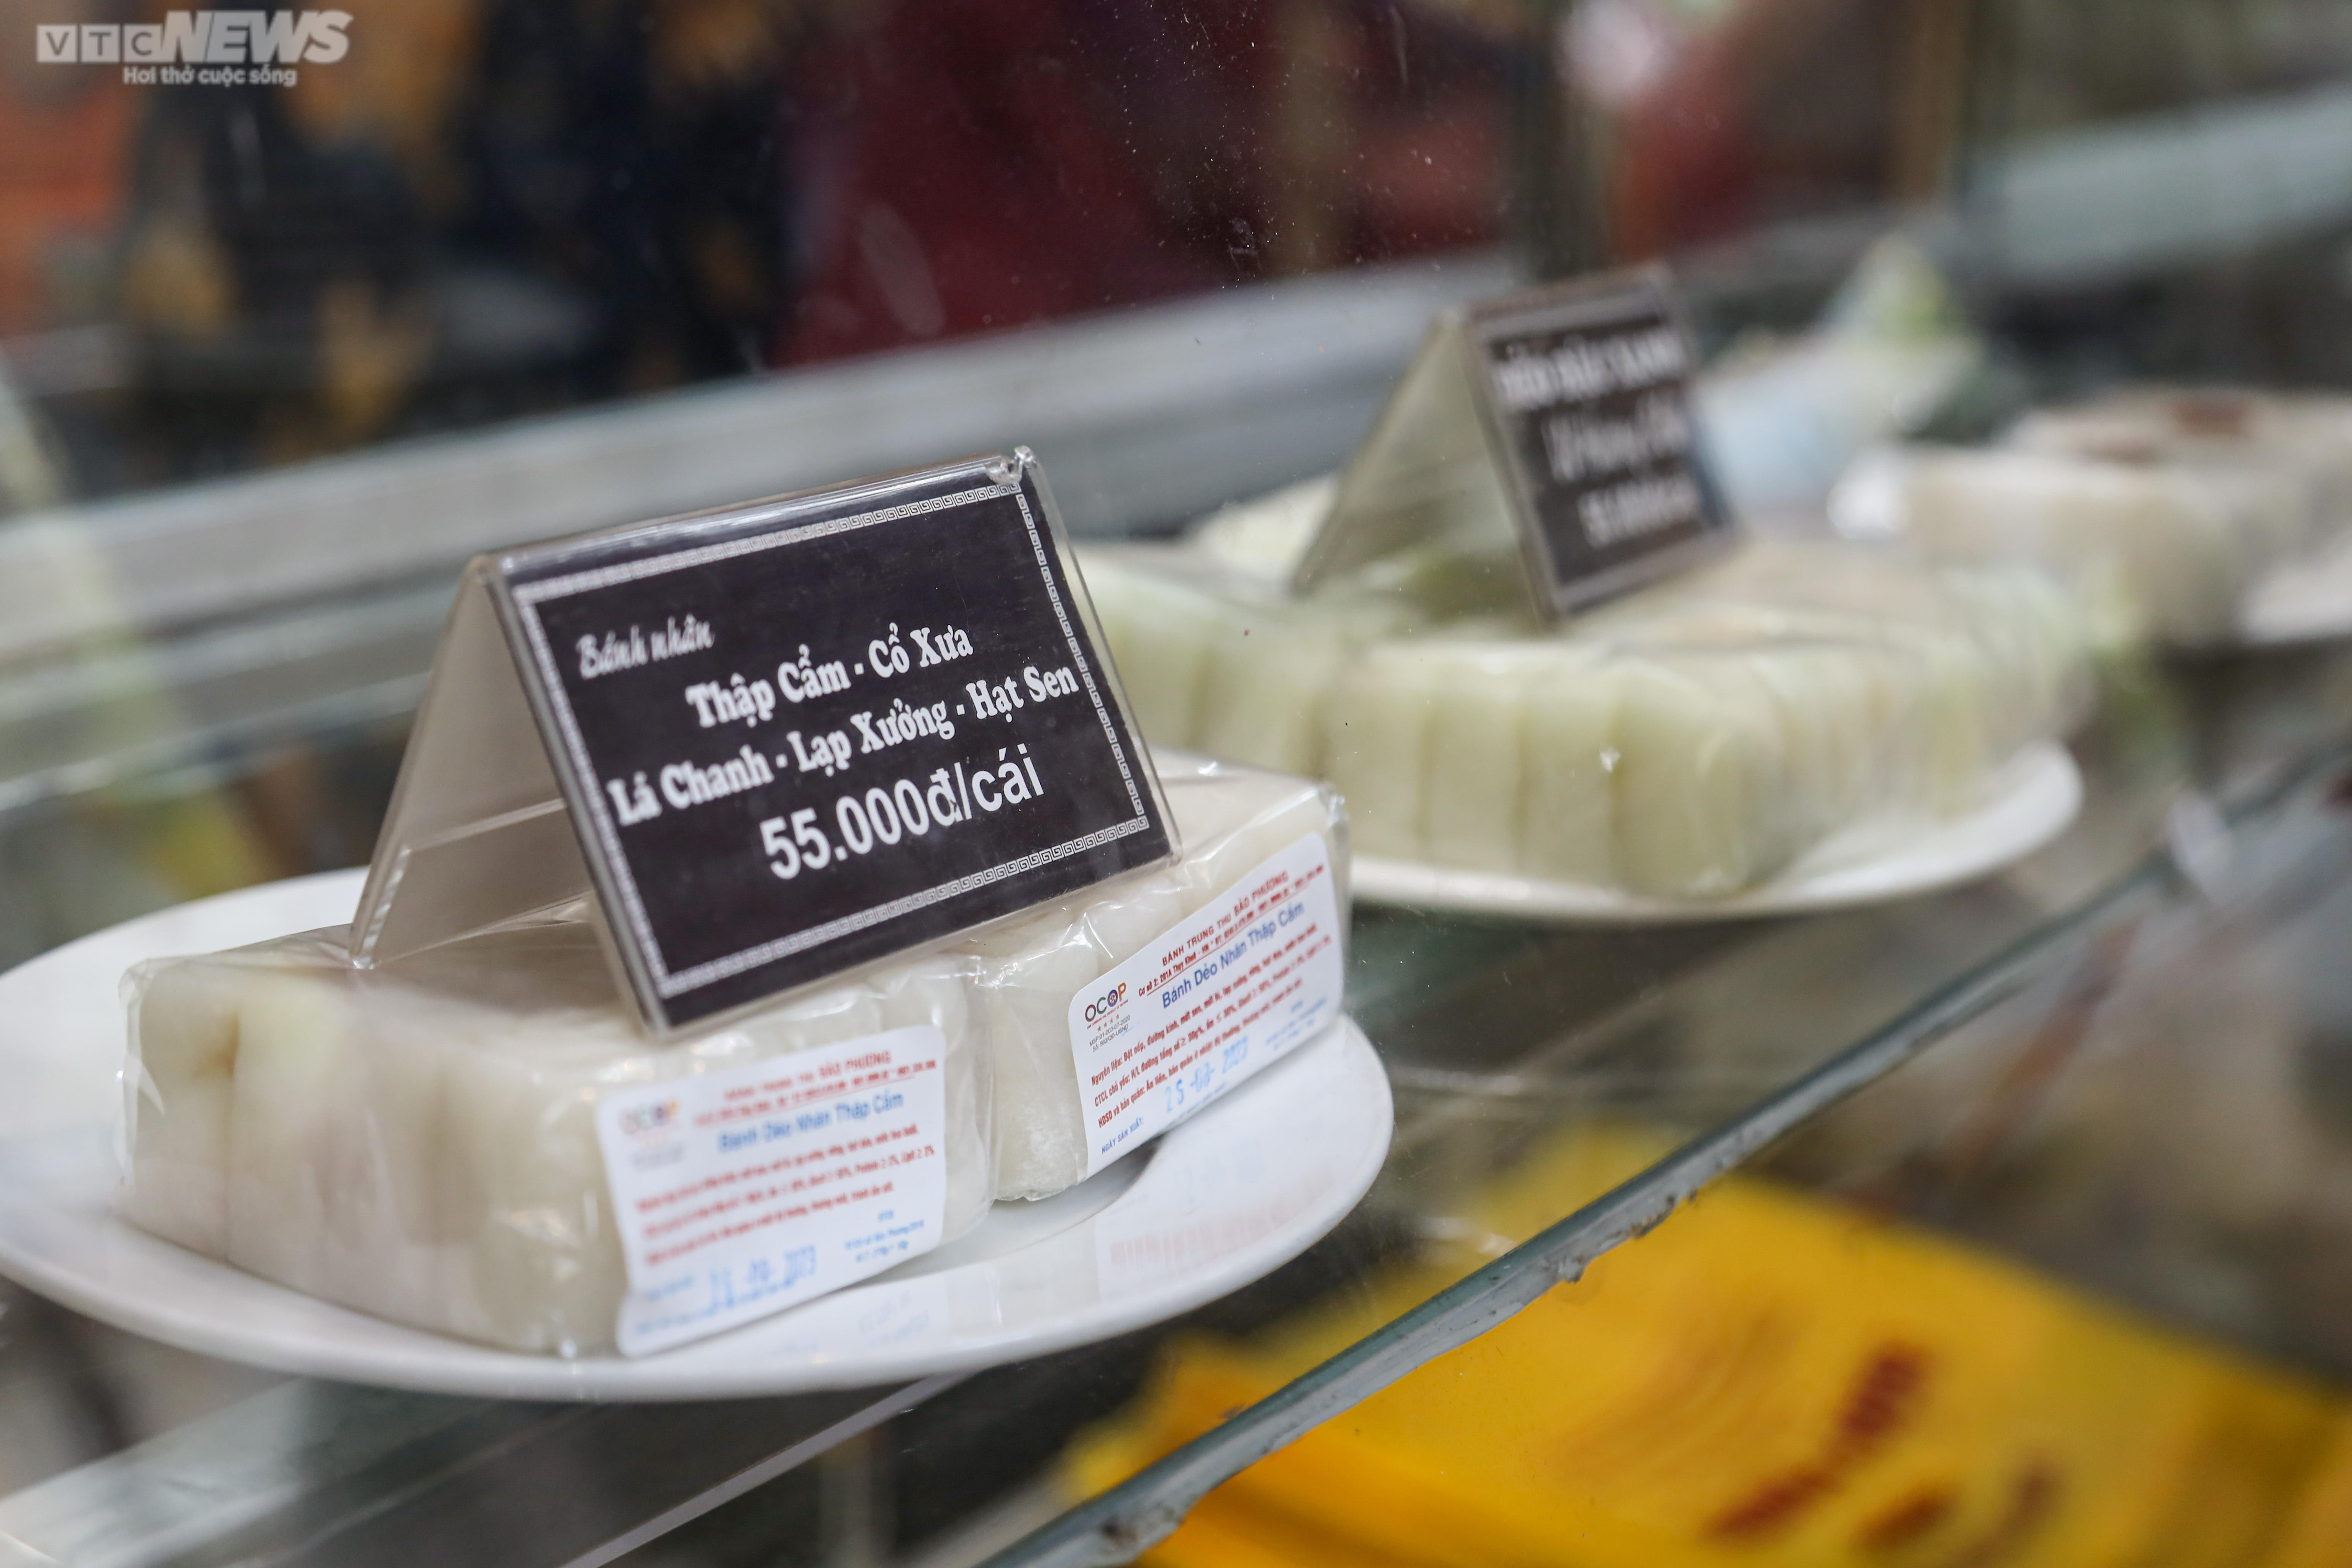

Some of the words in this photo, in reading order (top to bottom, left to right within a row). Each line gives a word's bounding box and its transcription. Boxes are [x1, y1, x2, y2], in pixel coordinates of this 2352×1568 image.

[578, 629, 648, 680] Bánh
[651, 614, 715, 664] nhân
[686, 675, 776, 730] Thập
[778, 644, 852, 704] Cẩm
[868, 622, 910, 679] Cổ
[910, 625, 974, 668] Xưa
[608, 769, 662, 828] Lá
[663, 746, 774, 811] Chanh
[787, 730, 852, 778] Lạp
[851, 699, 955, 755] Xưởng
[967, 678, 1025, 724] Hạt
[1023, 664, 1079, 703] Sen
[760, 743, 1045, 881] 55.000đ/cái
[1162, 945, 1184, 967] BÁNH
[1187, 925, 1214, 949] TRUNG
[1217, 913, 1231, 929] THU
[1162, 979, 1191, 1008] Bánh
[1194, 963, 1217, 986] Dẻo
[1220, 941, 1247, 970] Nhân
[1085, 982, 1127, 1022] OCOP
[1091, 1067, 1110, 1087] Nguyên
[1111, 1059, 1123, 1071] liệu:
[1124, 1049, 1133, 1062] Bột
[1134, 1041, 1146, 1055] nếp,
[1095, 1093, 1108, 1107] CTCL
[1109, 1083, 1119, 1096] chủ
[1119, 1075, 1130, 1090] yếu:
[1098, 1111, 1112, 1128] HDSD
[1113, 1104, 1120, 1116] và
[1120, 1097, 1130, 1112] bảo
[1131, 1086, 1145, 1103] quản:
[1101, 1139, 1116, 1155] NGÀY
[1117, 1129, 1128, 1143] SẢN
